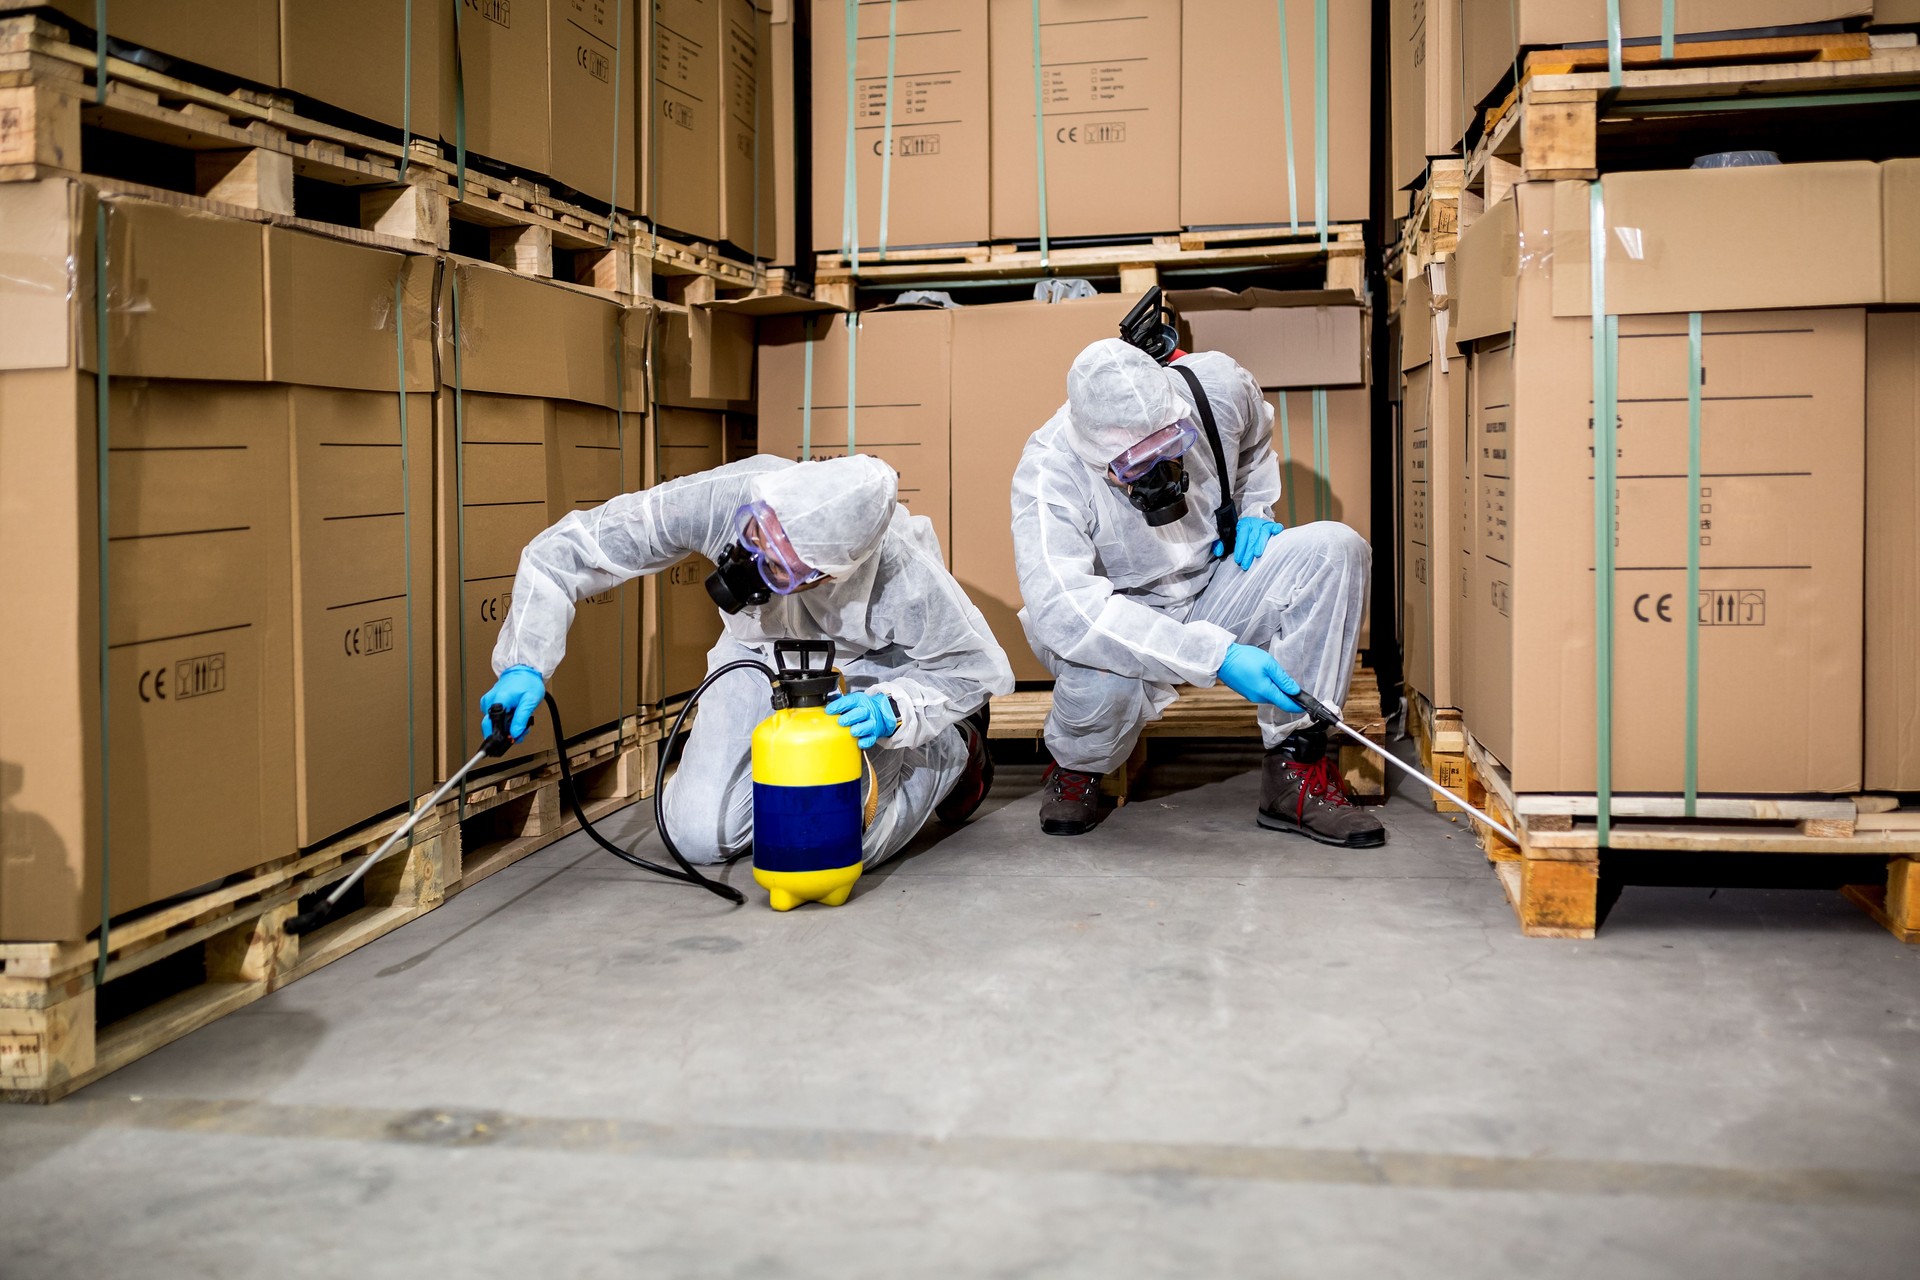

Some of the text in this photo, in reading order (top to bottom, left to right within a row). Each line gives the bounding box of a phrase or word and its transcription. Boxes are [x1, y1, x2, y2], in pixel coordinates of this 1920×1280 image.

[577, 45, 588, 70] CE
[663, 99, 673, 119] CE
[1056, 126, 1078, 144] CE
[670, 566, 680, 585] CE
[480, 597, 497, 622] CE
[1633, 593, 1673, 623] CE
[344, 627, 360, 657] CE
[138, 667, 167, 703] CE
